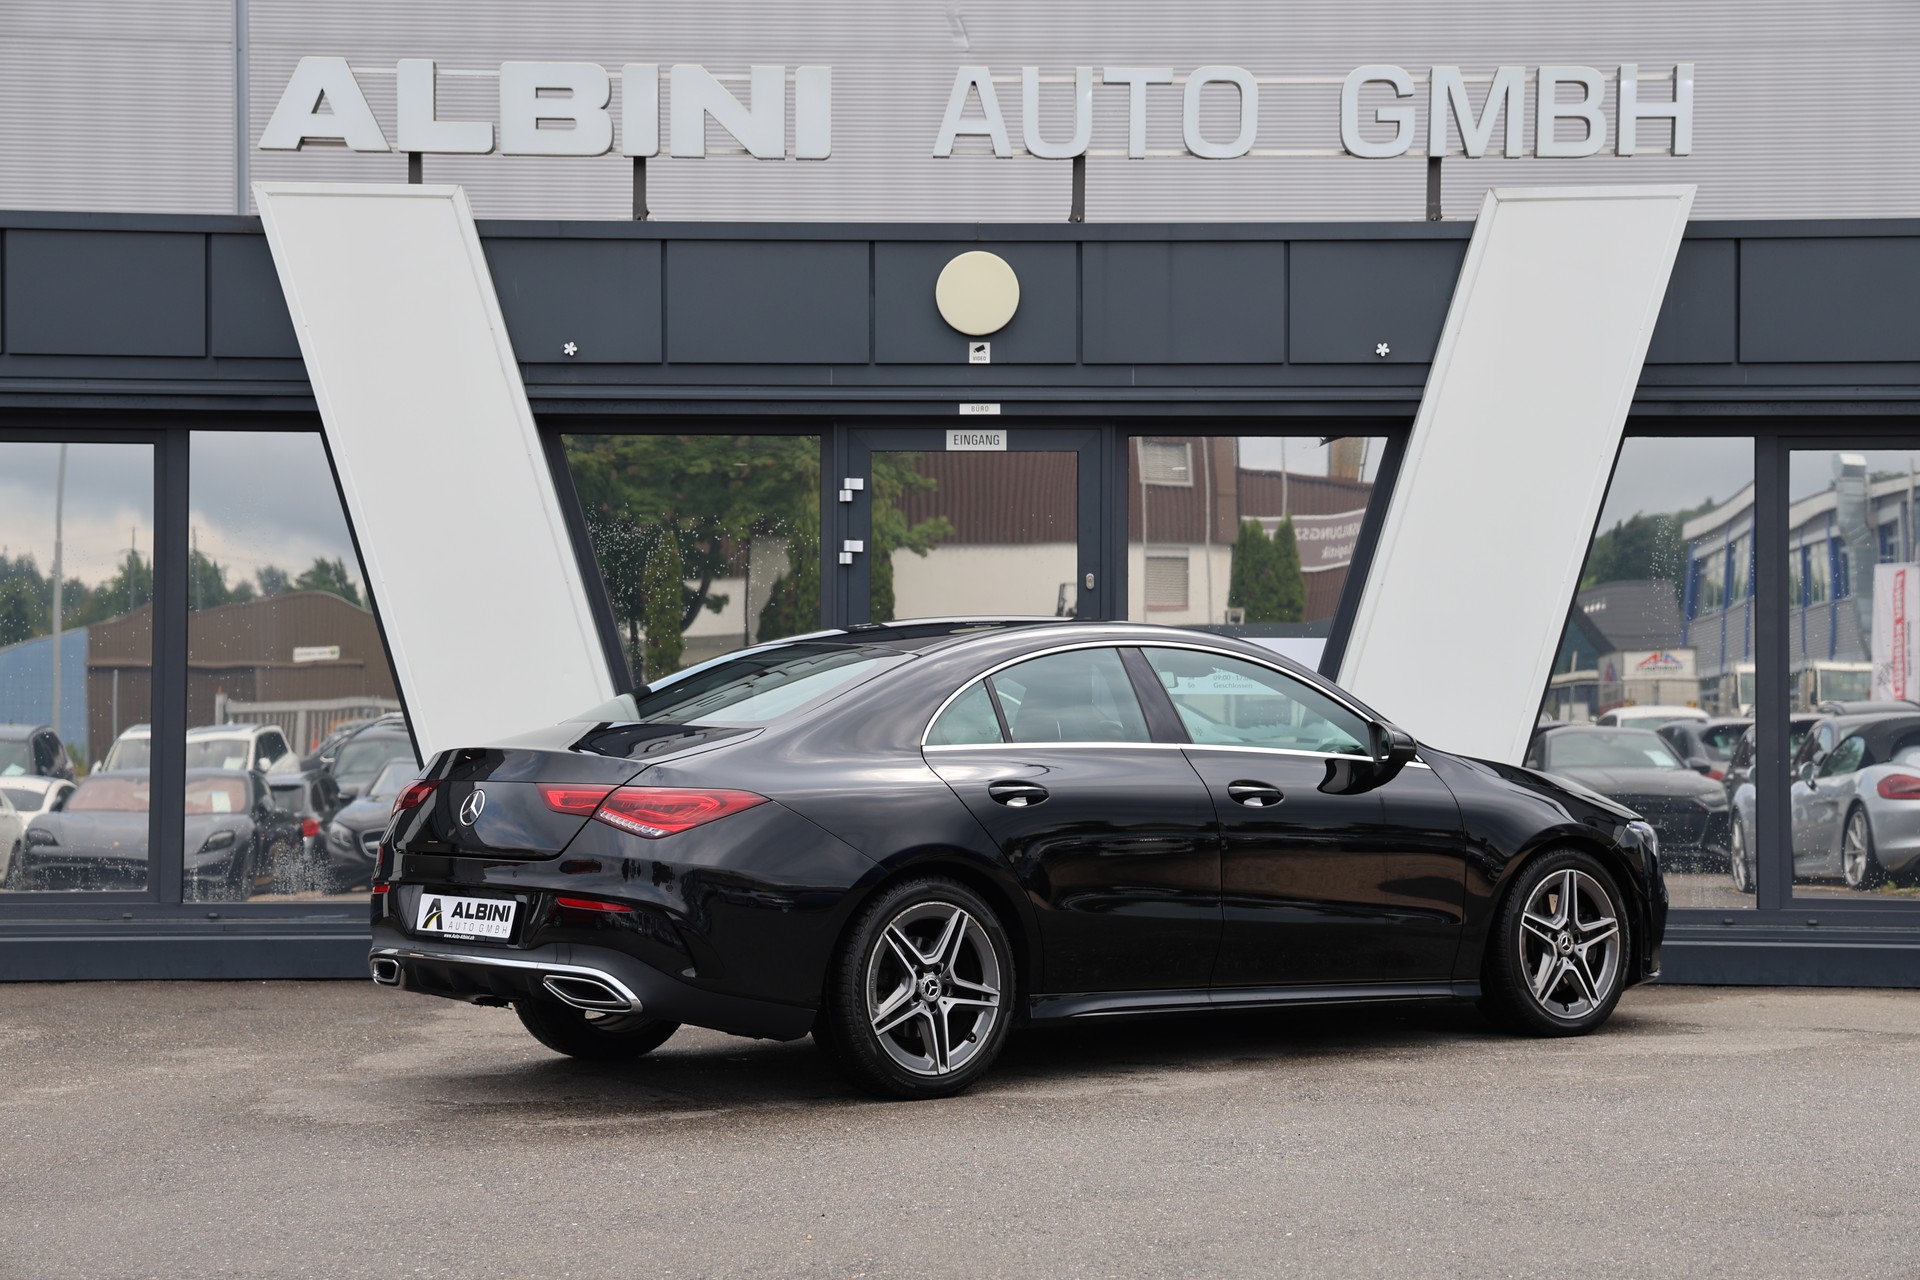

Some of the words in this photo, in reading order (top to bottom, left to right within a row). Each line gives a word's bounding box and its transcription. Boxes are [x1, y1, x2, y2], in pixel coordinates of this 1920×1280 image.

[258, 56, 832, 160] ALBINI
[932, 65, 1259, 160] AUTO
[1339, 63, 1695, 160] GMBH
[953, 434, 1000, 445] EINGANG
[451, 901, 512, 923] ALBINI
[448, 921, 474, 932] AUTO
[478, 923, 509, 935] GMBH
